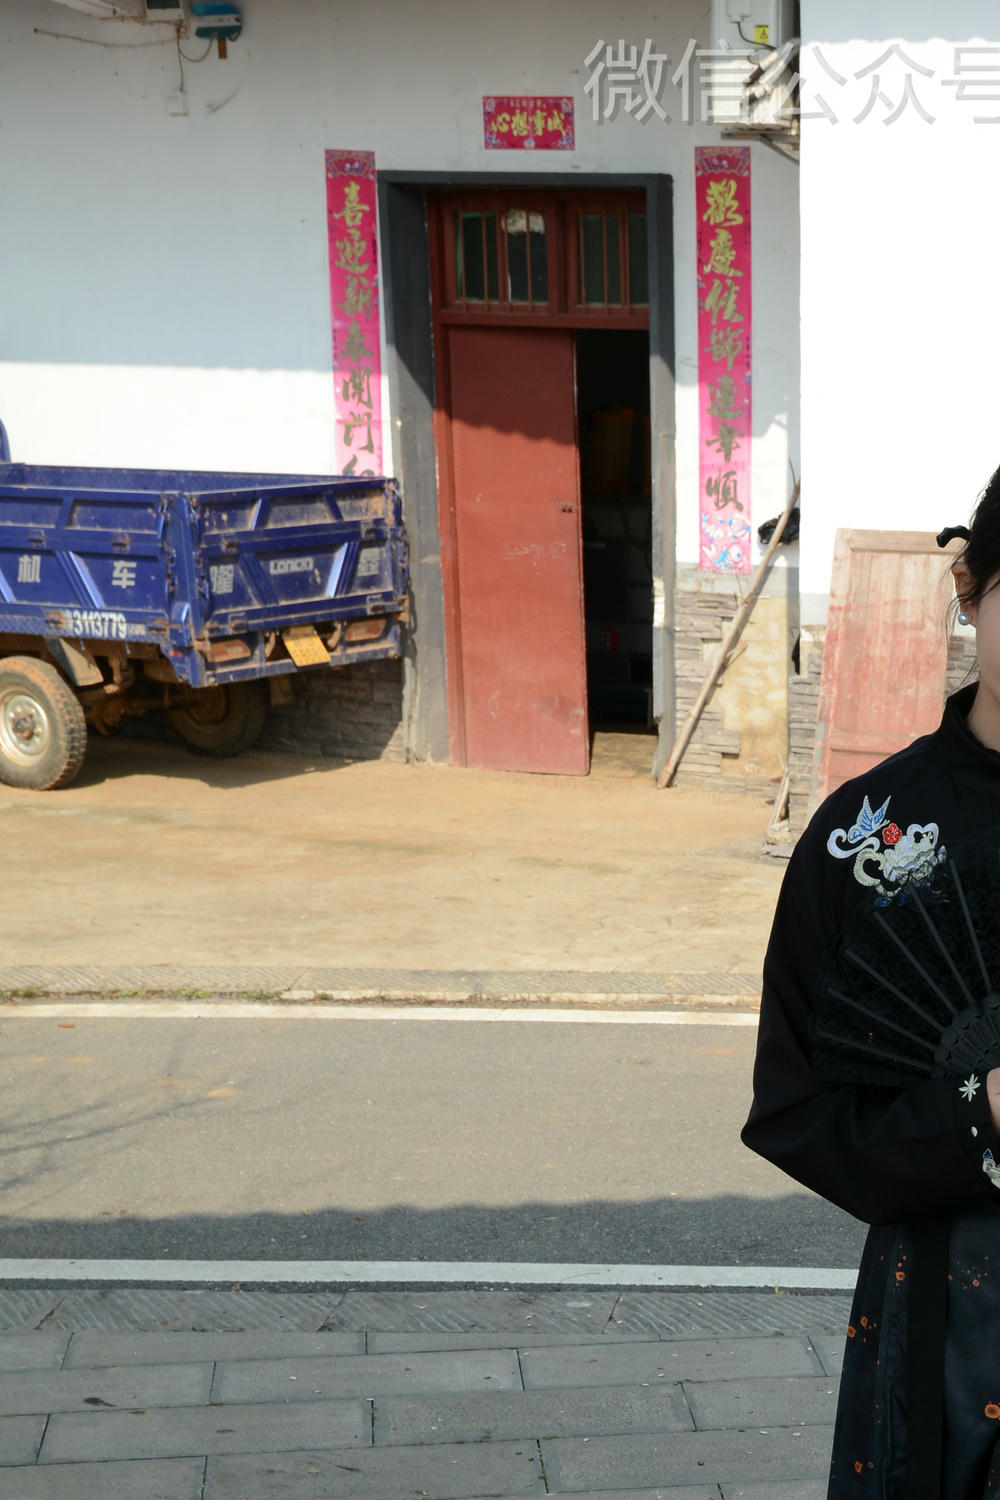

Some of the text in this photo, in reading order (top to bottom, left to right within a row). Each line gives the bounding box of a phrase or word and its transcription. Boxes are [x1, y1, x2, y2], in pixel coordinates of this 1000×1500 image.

[491, 109, 566, 136] 心想事成
[17, 554, 137, 589] 机 车
[209, 564, 234, 594] 隆
[357, 547, 380, 576] 鑫
